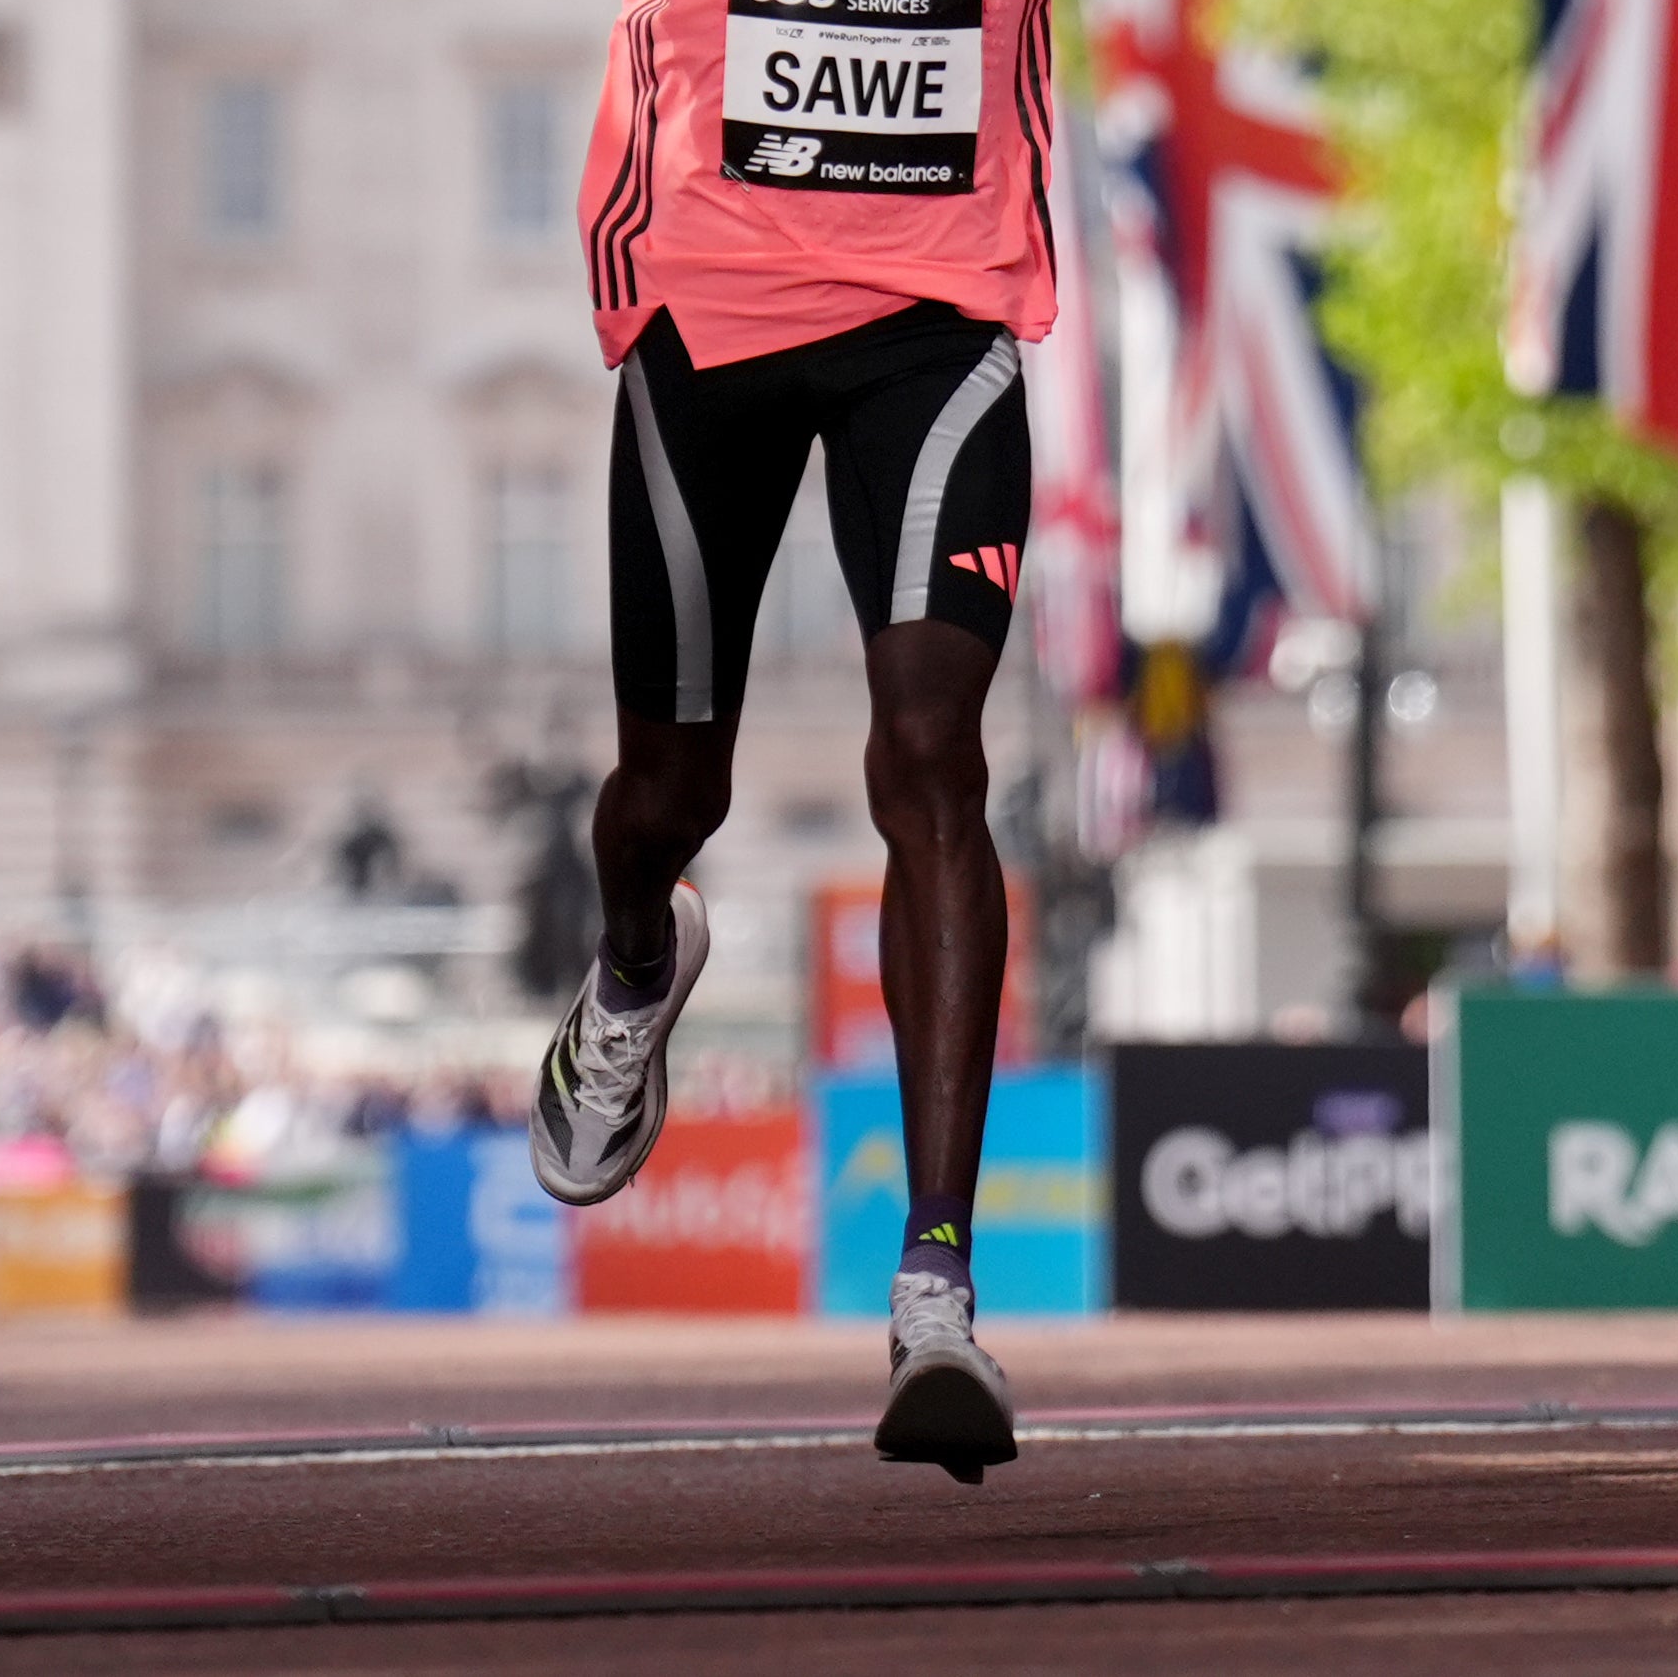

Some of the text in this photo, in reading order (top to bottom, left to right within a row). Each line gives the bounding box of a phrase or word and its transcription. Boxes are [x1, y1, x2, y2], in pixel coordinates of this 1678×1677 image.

[818, 30, 902, 45] #WeRunTogether
[762, 50, 948, 119] SAWE
[820, 162, 865, 181] new
[869, 162, 952, 183] balance
